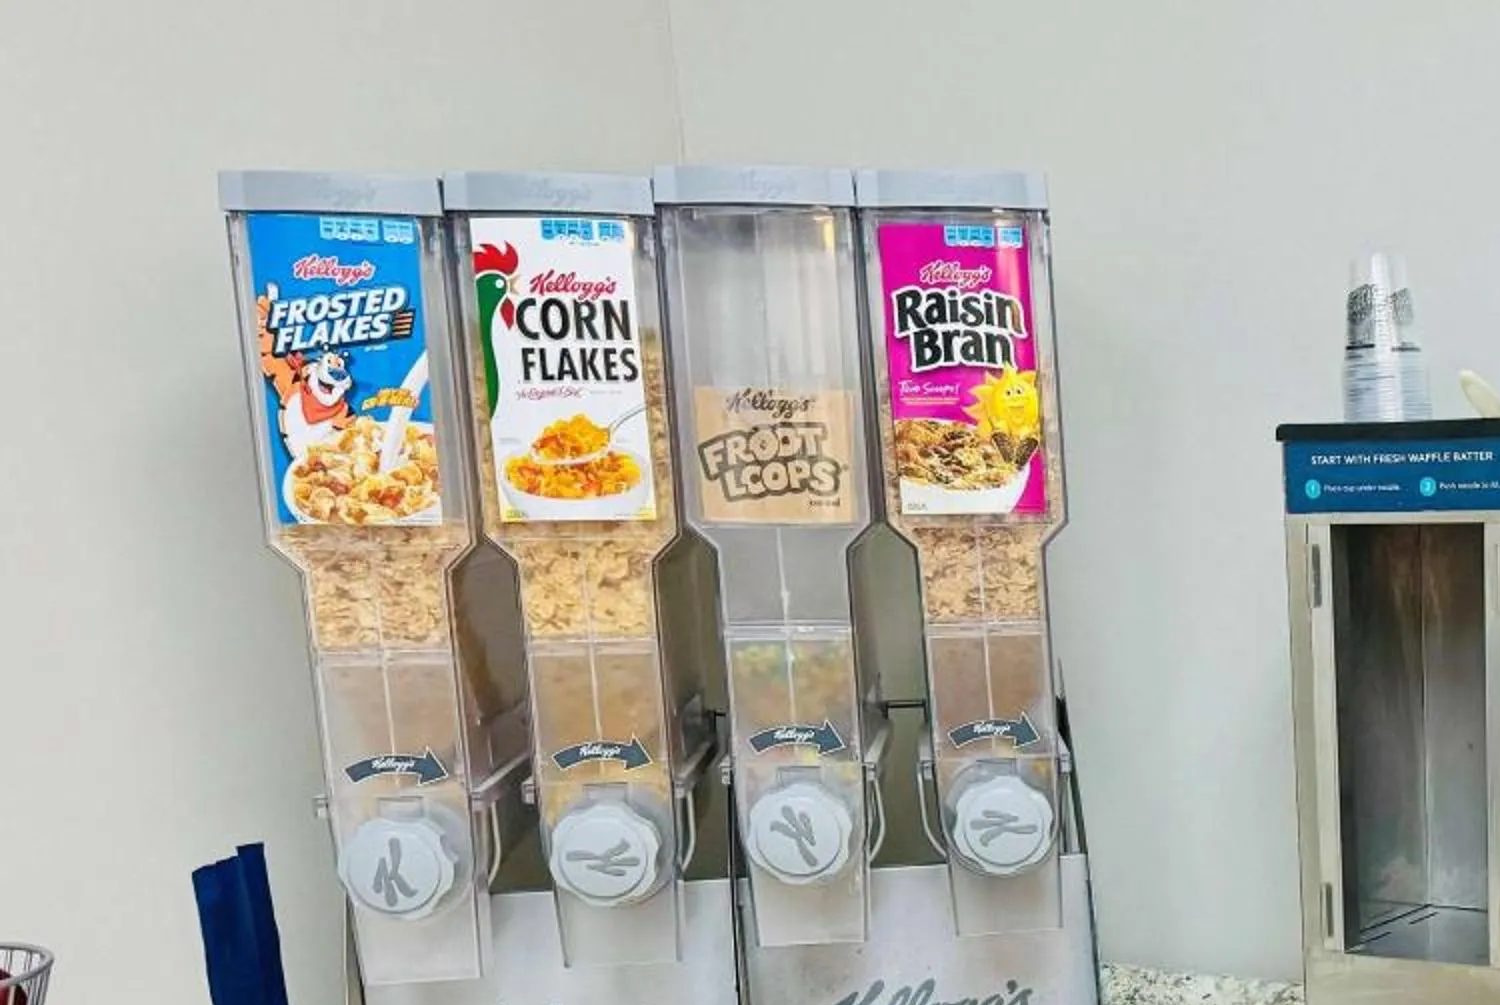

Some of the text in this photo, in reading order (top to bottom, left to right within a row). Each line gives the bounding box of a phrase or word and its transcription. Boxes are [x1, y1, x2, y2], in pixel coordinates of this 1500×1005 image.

[294, 255, 374, 285] Kellogg's
[529, 269, 617, 300] Kellogg's
[919, 261, 992, 288] Kellogg's
[270, 288, 405, 329] FROSTED
[516, 297, 632, 341] CORN
[895, 287, 1025, 335] Raisin
[275, 313, 391, 354] FLAKES
[912, 327, 1014, 369] Bran
[521, 347, 639, 382] FLAKES
[699, 421, 828, 481] FROOT
[1311, 451, 1493, 465] START WITH FRESH WAFFLE BATTER
[773, 728, 815, 743] Kellogg's
[973, 722, 1011, 736] Kellogg's
[371, 757, 415, 771] Kellogg's
[579, 743, 620, 758] Kellogg's
[373, 838, 418, 906] K
